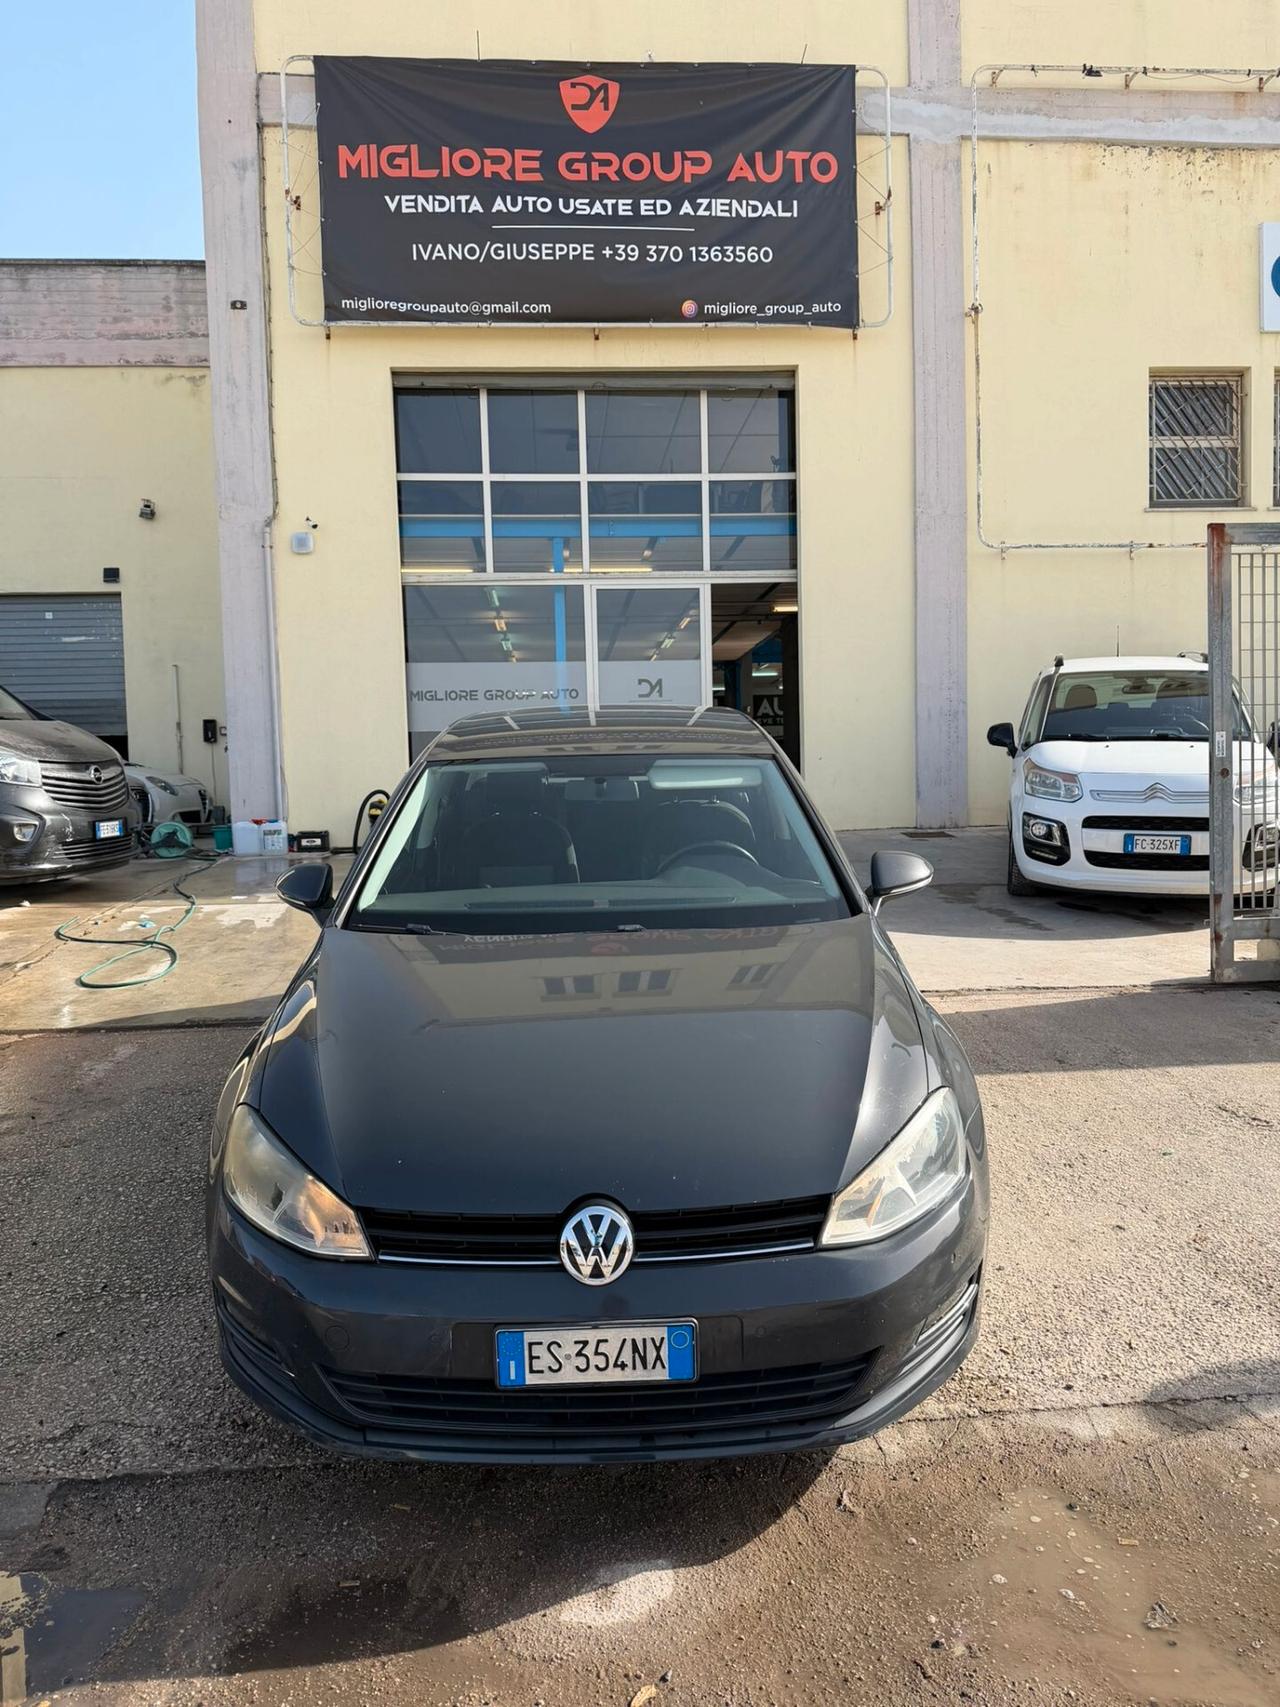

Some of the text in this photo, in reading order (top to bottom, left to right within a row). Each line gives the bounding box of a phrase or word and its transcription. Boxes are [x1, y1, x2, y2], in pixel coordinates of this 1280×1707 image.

[337, 143, 839, 184] MIGLIORE GROUP AUTO
[383, 194, 799, 219] VENDITA AUTO USATE ED AZIENDALI
[411, 240, 774, 264] IVANO/GIUSEPPE +39 370 1363560
[341, 296, 552, 315] miglioregroupauto@gmail.com
[703, 301, 842, 317] migliore_group_auto
[409, 687, 579, 702] MIGLIORE GROUP AUTO
